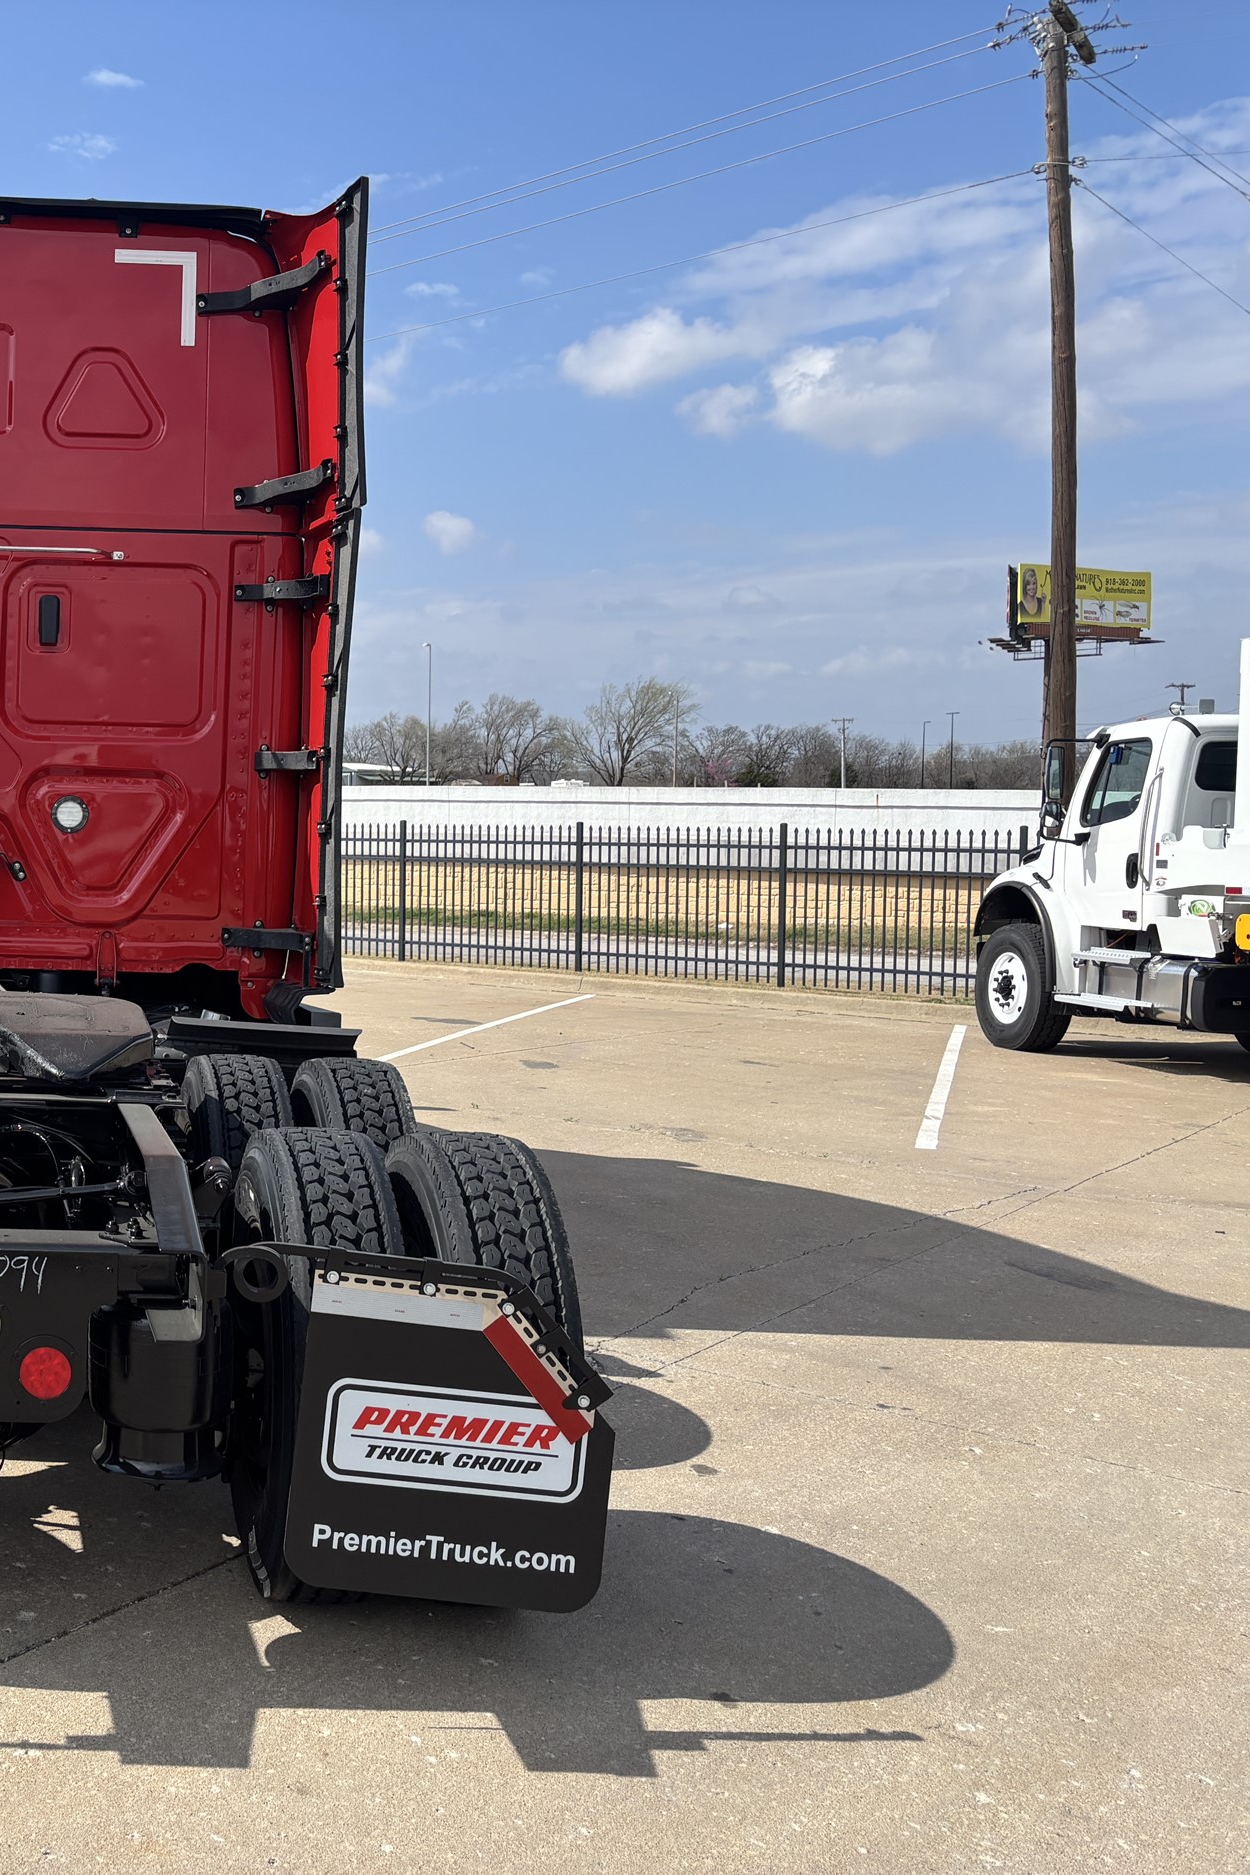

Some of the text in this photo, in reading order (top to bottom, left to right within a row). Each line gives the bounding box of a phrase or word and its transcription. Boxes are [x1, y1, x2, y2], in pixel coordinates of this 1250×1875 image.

[1105, 577, 1146, 587] 918-362-2000
[352, 1406, 561, 1450] PREMIER
[364, 1444, 543, 1476] TRUCK GROUP
[311, 1523, 577, 1574] PremierTruck.com
